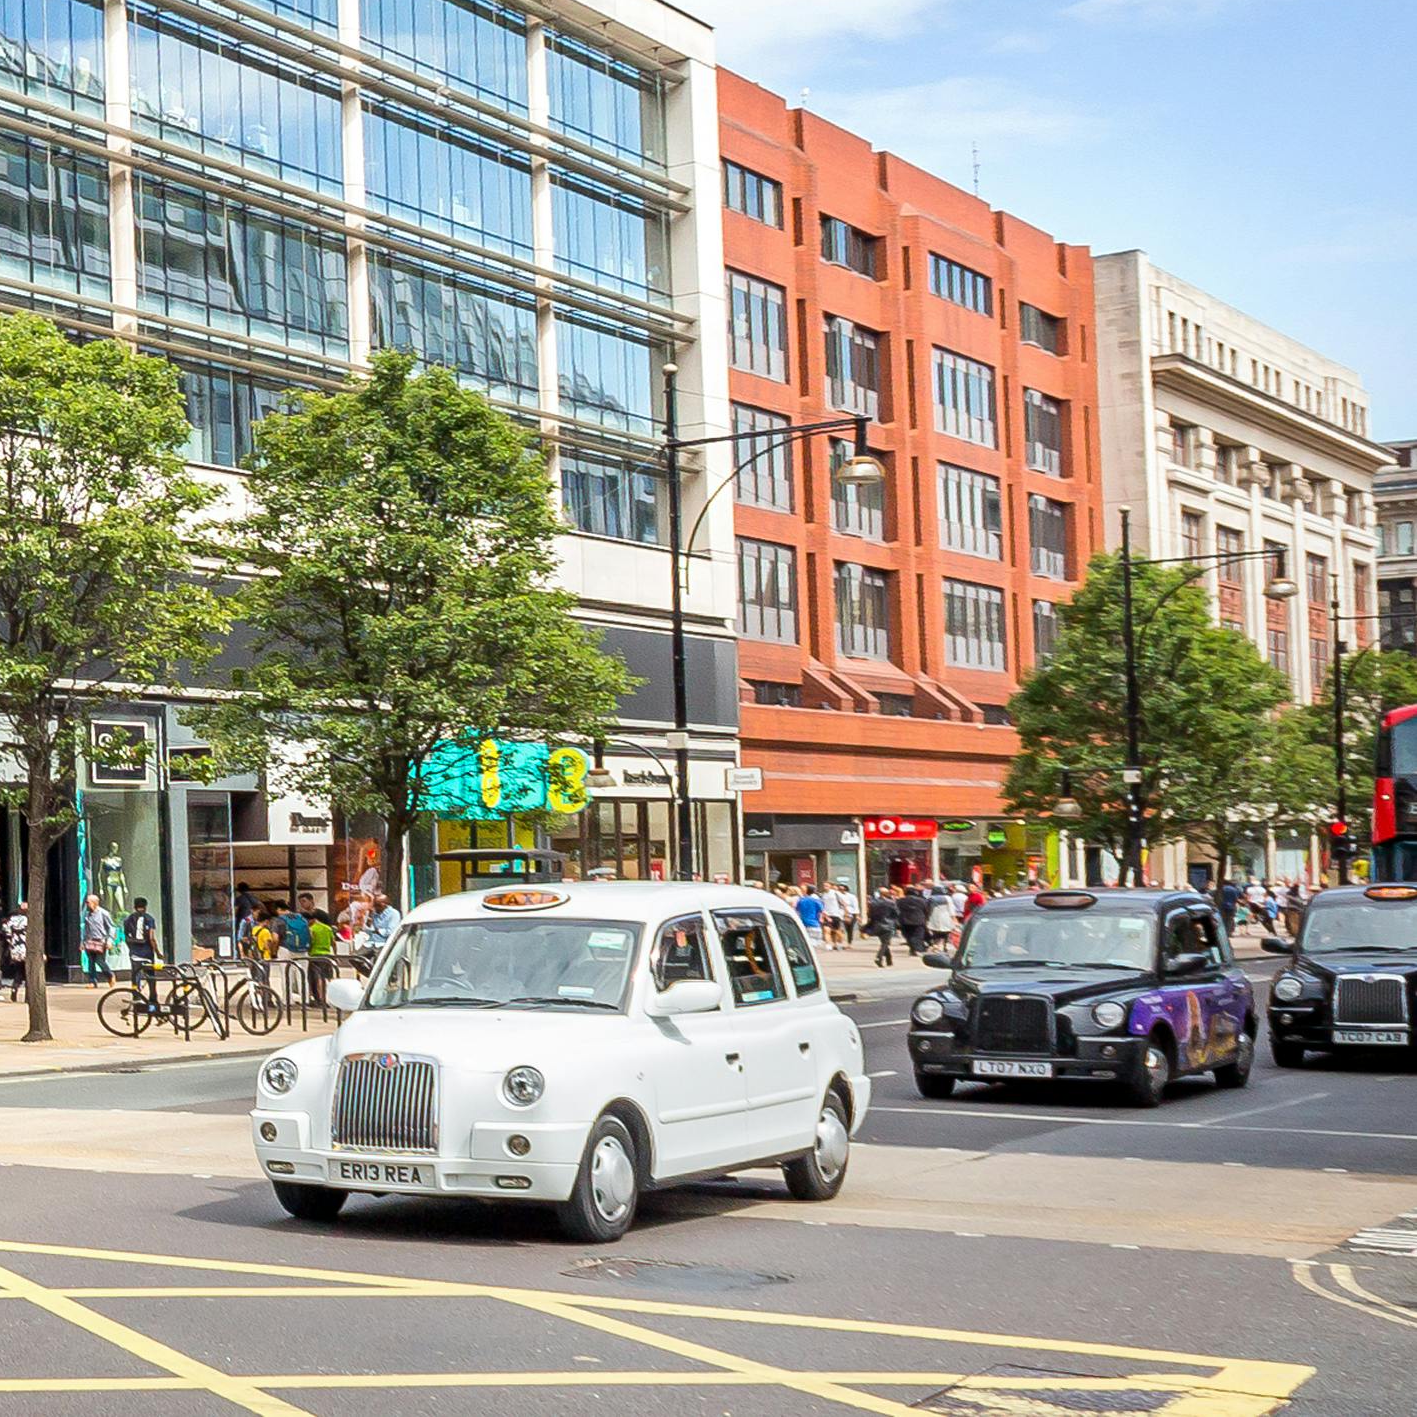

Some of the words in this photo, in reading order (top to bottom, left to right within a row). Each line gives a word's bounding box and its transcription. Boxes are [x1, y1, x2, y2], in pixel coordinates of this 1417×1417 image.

[1376, 1032, 1402, 1042] CAB
[341, 1162, 380, 1182] ER13
[384, 1165, 422, 1184] REA
